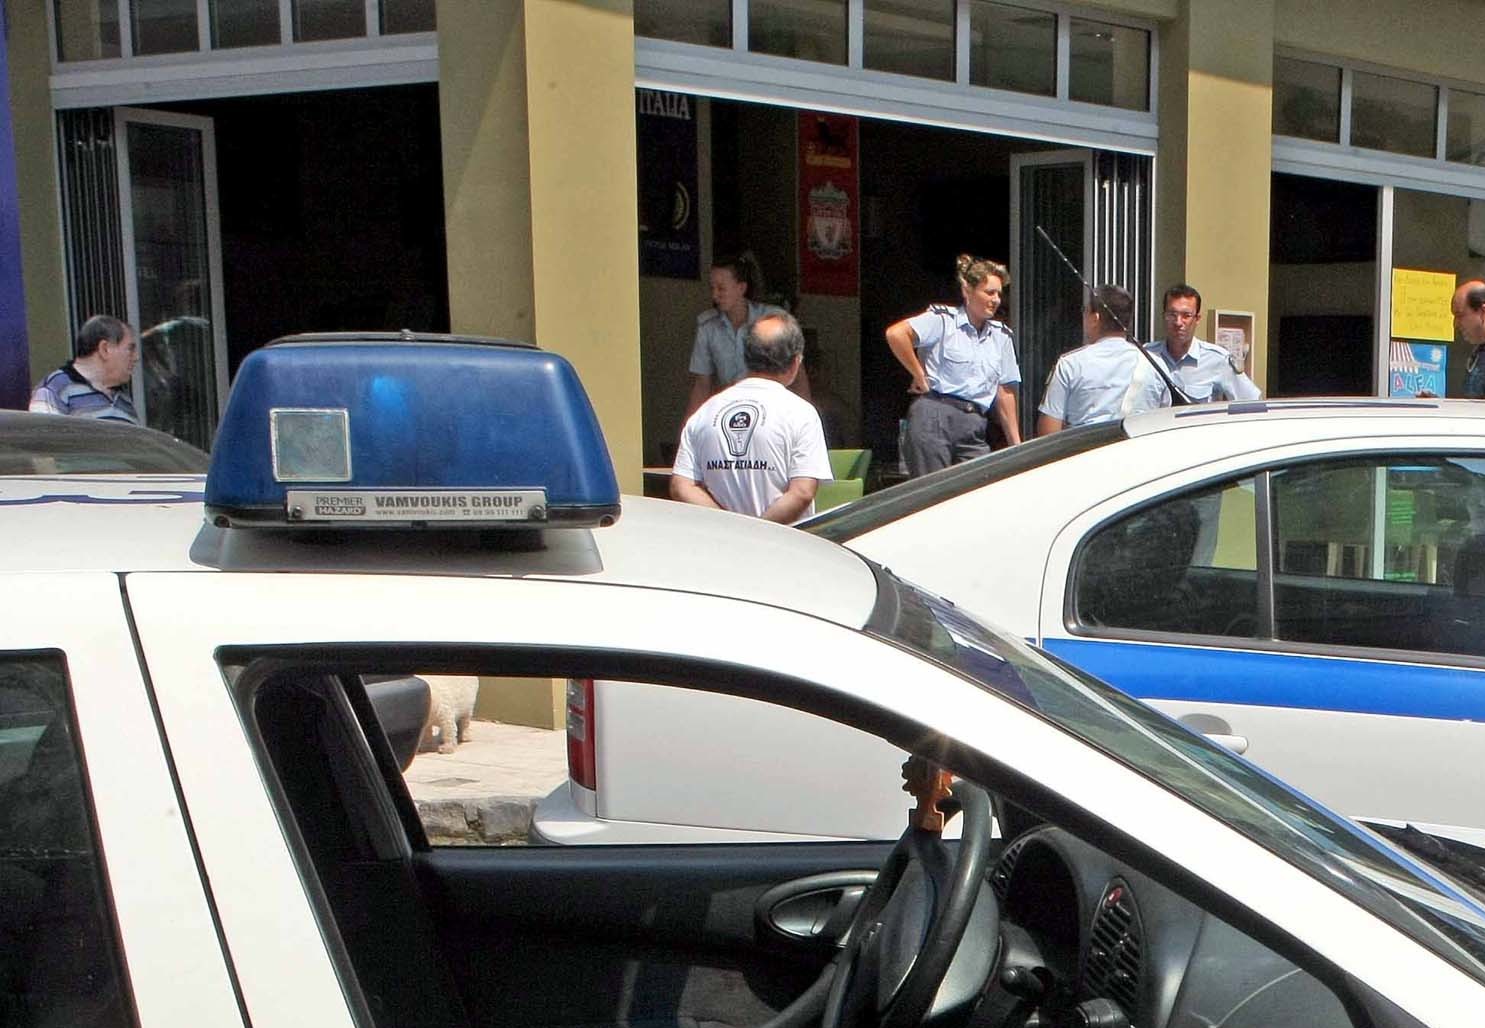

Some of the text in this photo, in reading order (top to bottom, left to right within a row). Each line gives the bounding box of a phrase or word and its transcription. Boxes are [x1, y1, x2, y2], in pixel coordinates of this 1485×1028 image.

[316, 495, 523, 508] PREMIER VAMVOUKIS GROUP
